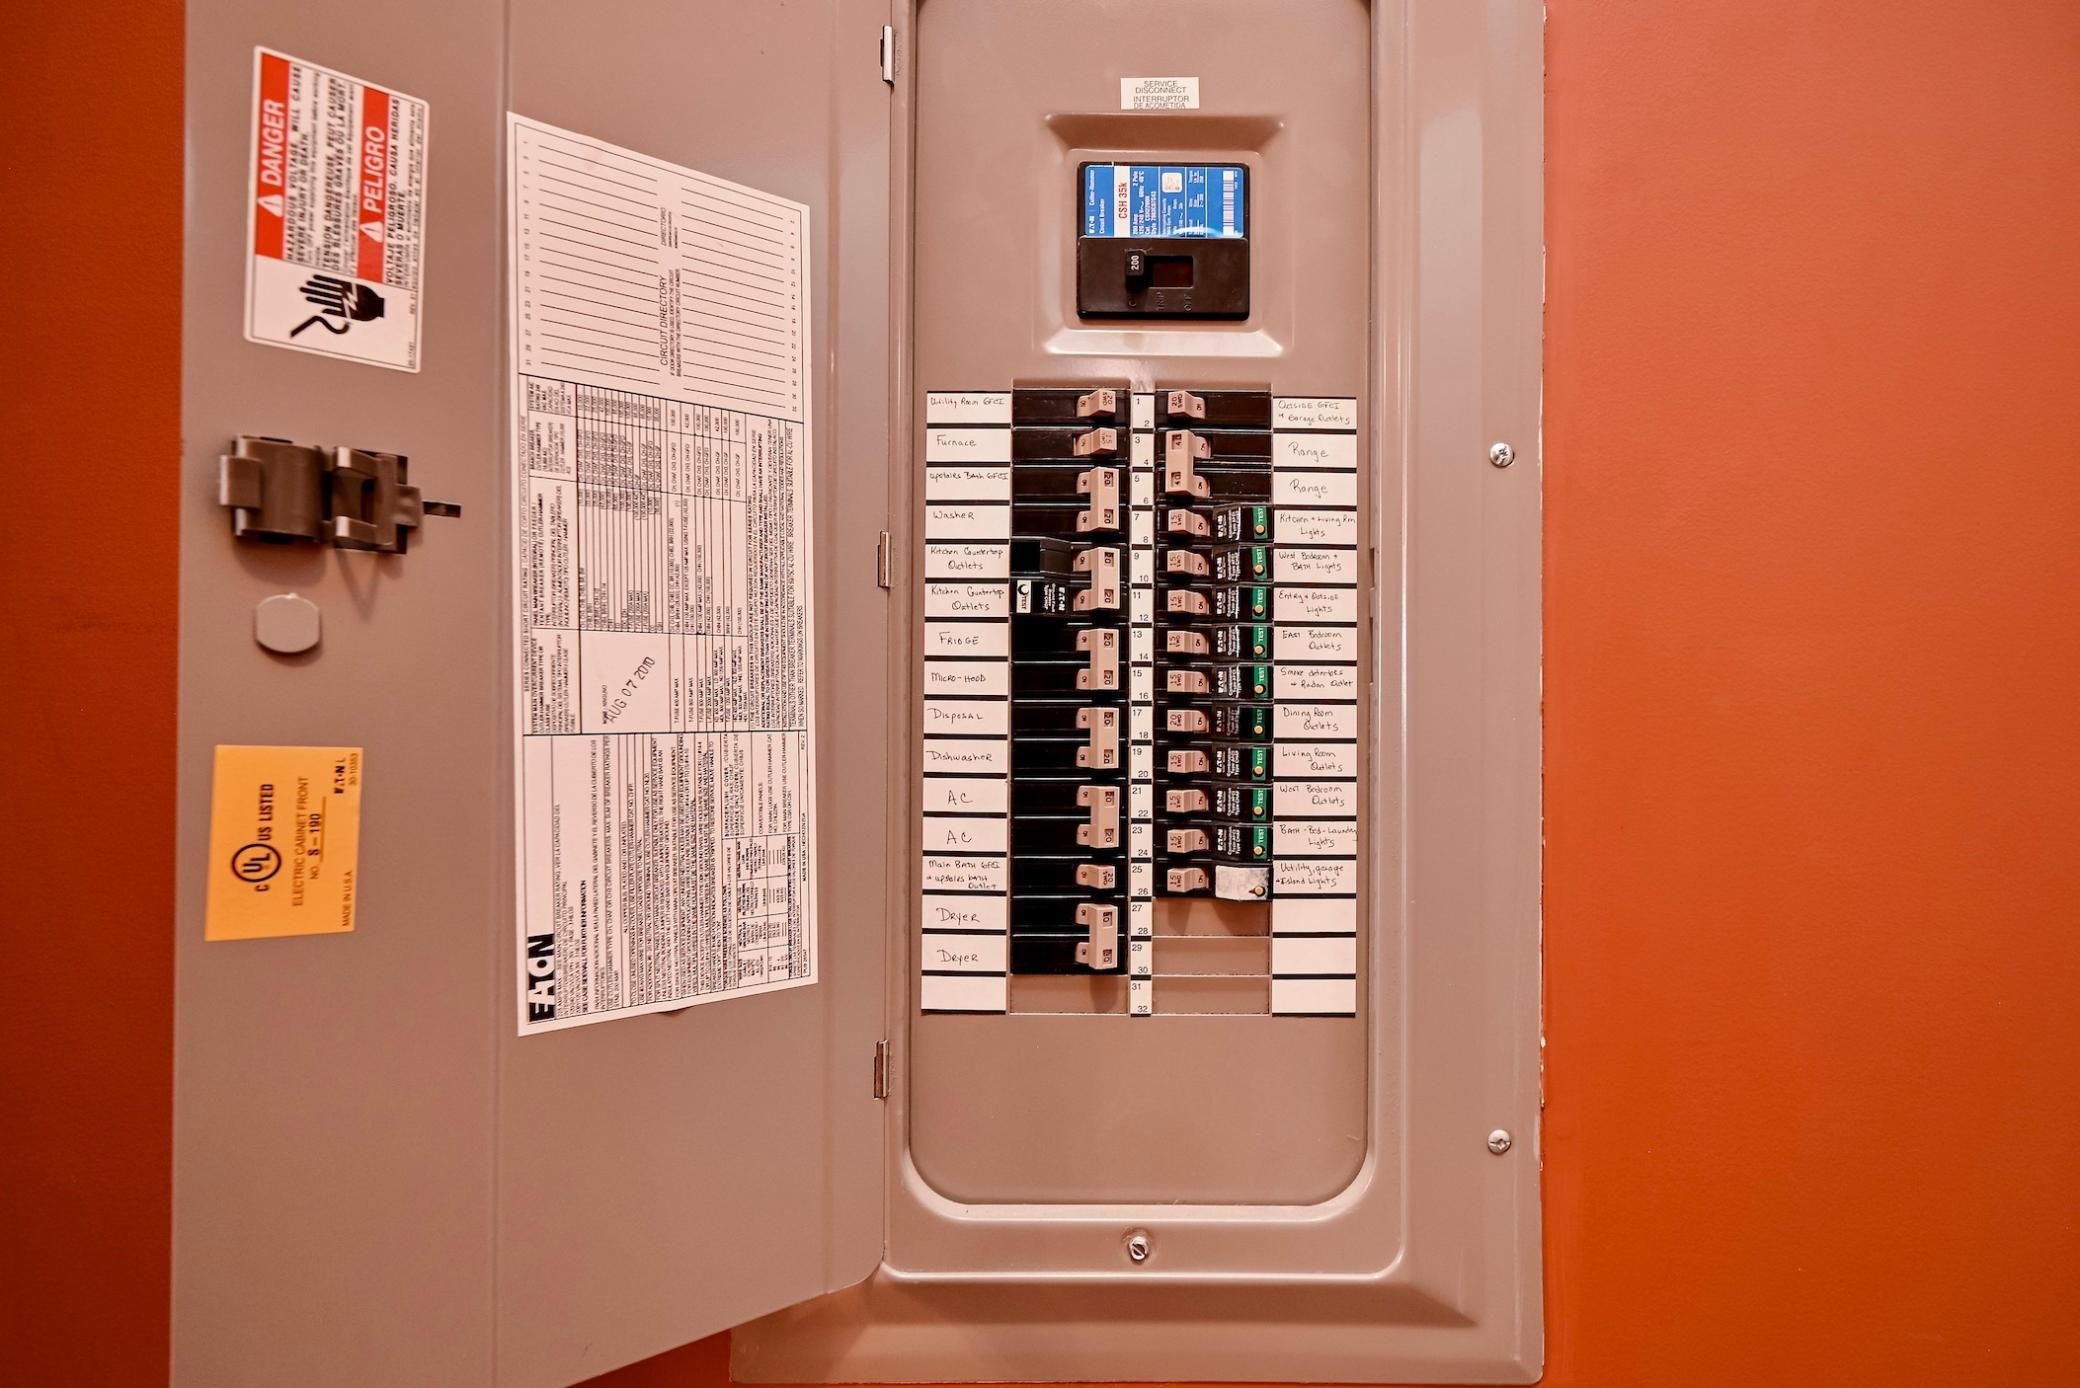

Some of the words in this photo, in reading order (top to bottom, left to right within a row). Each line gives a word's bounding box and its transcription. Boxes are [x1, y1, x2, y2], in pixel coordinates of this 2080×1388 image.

[292, 65, 301, 101] CAUSE
[1144, 80, 1177, 88] SERVICE
[328, 77, 338, 118] CAUSER
[1133, 95, 1190, 103] INTERRUPTOR
[290, 108, 299, 133] WILL
[336, 113, 345, 127] LA
[389, 98, 400, 141] HERIDAS
[327, 121, 337, 149] PEUT
[336, 129, 345, 145] OU
[260, 99, 285, 187] DANGER
[388, 144, 398, 177] CAUSA
[335, 147, 344, 188] GRAVES
[364, 125, 385, 214] PELIGRO
[299, 168, 307, 183] OR
[297, 186, 307, 223] INJURY
[1118, 200, 1128, 219] CSH
[332, 190, 343, 248] BLESSURES
[287, 195, 298, 260] HAZARDOUS
[659, 206, 667, 246] DIRECTORIO
[296, 225, 306, 263] SEVERE
[322, 225, 332, 269] TENSION
[331, 249, 340, 272] DES
[386, 242, 396, 284] VOLTAJE
[395, 243, 404, 286] SEVERAS
[1130, 255, 1140, 271] 200
[659, 274, 668, 329] DIRECTORY
[660, 329, 668, 366] CIRCUIT
[1135, 397, 1140, 406] 1
[1143, 419, 1149, 427] 2
[936, 434, 977, 447] Furnace
[1134, 436, 1140, 445] 3
[1288, 441, 1329, 463] Range
[1143, 458, 1149, 466] 4
[1134, 474, 1140, 483] 5
[1289, 478, 1329, 499] Range
[1143, 496, 1149, 504] 6
[1134, 513, 1140, 522] 7
[1143, 535, 1149, 543] 8
[1134, 552, 1140, 561] 9
[947, 560, 984, 571] Outlets
[1139, 574, 1149, 582] 10
[1132, 591, 1141, 600] 11
[1139, 613, 1149, 621] 12
[1132, 630, 1142, 639] 13
[1139, 652, 1149, 660] 14
[1132, 669, 1142, 678] 15
[605, 699, 627, 723] AUG
[621, 679, 638, 697] 07
[634, 656, 655, 680] 2010
[1139, 692, 1149, 700] 16
[1132, 708, 1142, 717] 17
[1139, 731, 1149, 739] 18
[1132, 747, 1142, 756] 19
[1281, 745, 1313, 762] Living
[1138, 770, 1149, 778] 20
[296, 776, 309, 810] FRONT
[1132, 787, 1142, 796] 21
[258, 783, 274, 822] LISTED
[1138, 809, 1149, 817] 22
[257, 827, 272, 841] US
[294, 813, 307, 855] CABINET
[1132, 826, 1142, 835] 23
[1138, 848, 1149, 856] 24
[242, 852, 271, 874] UL
[1132, 865, 1142, 874] 25
[292, 857, 305, 907] ELECTRIC
[343, 892, 351, 901] IN
[1138, 887, 1149, 895] 26
[342, 902, 351, 927] MADE
[1132, 904, 1142, 913] 27
[1138, 927, 1149, 935] 28
[1132, 943, 1142, 952] 29
[1138, 966, 1149, 974] 30
[528, 933, 555, 1023] EATON
[1132, 982, 1141, 991] 31
[1138, 1005, 1149, 1013] 32
